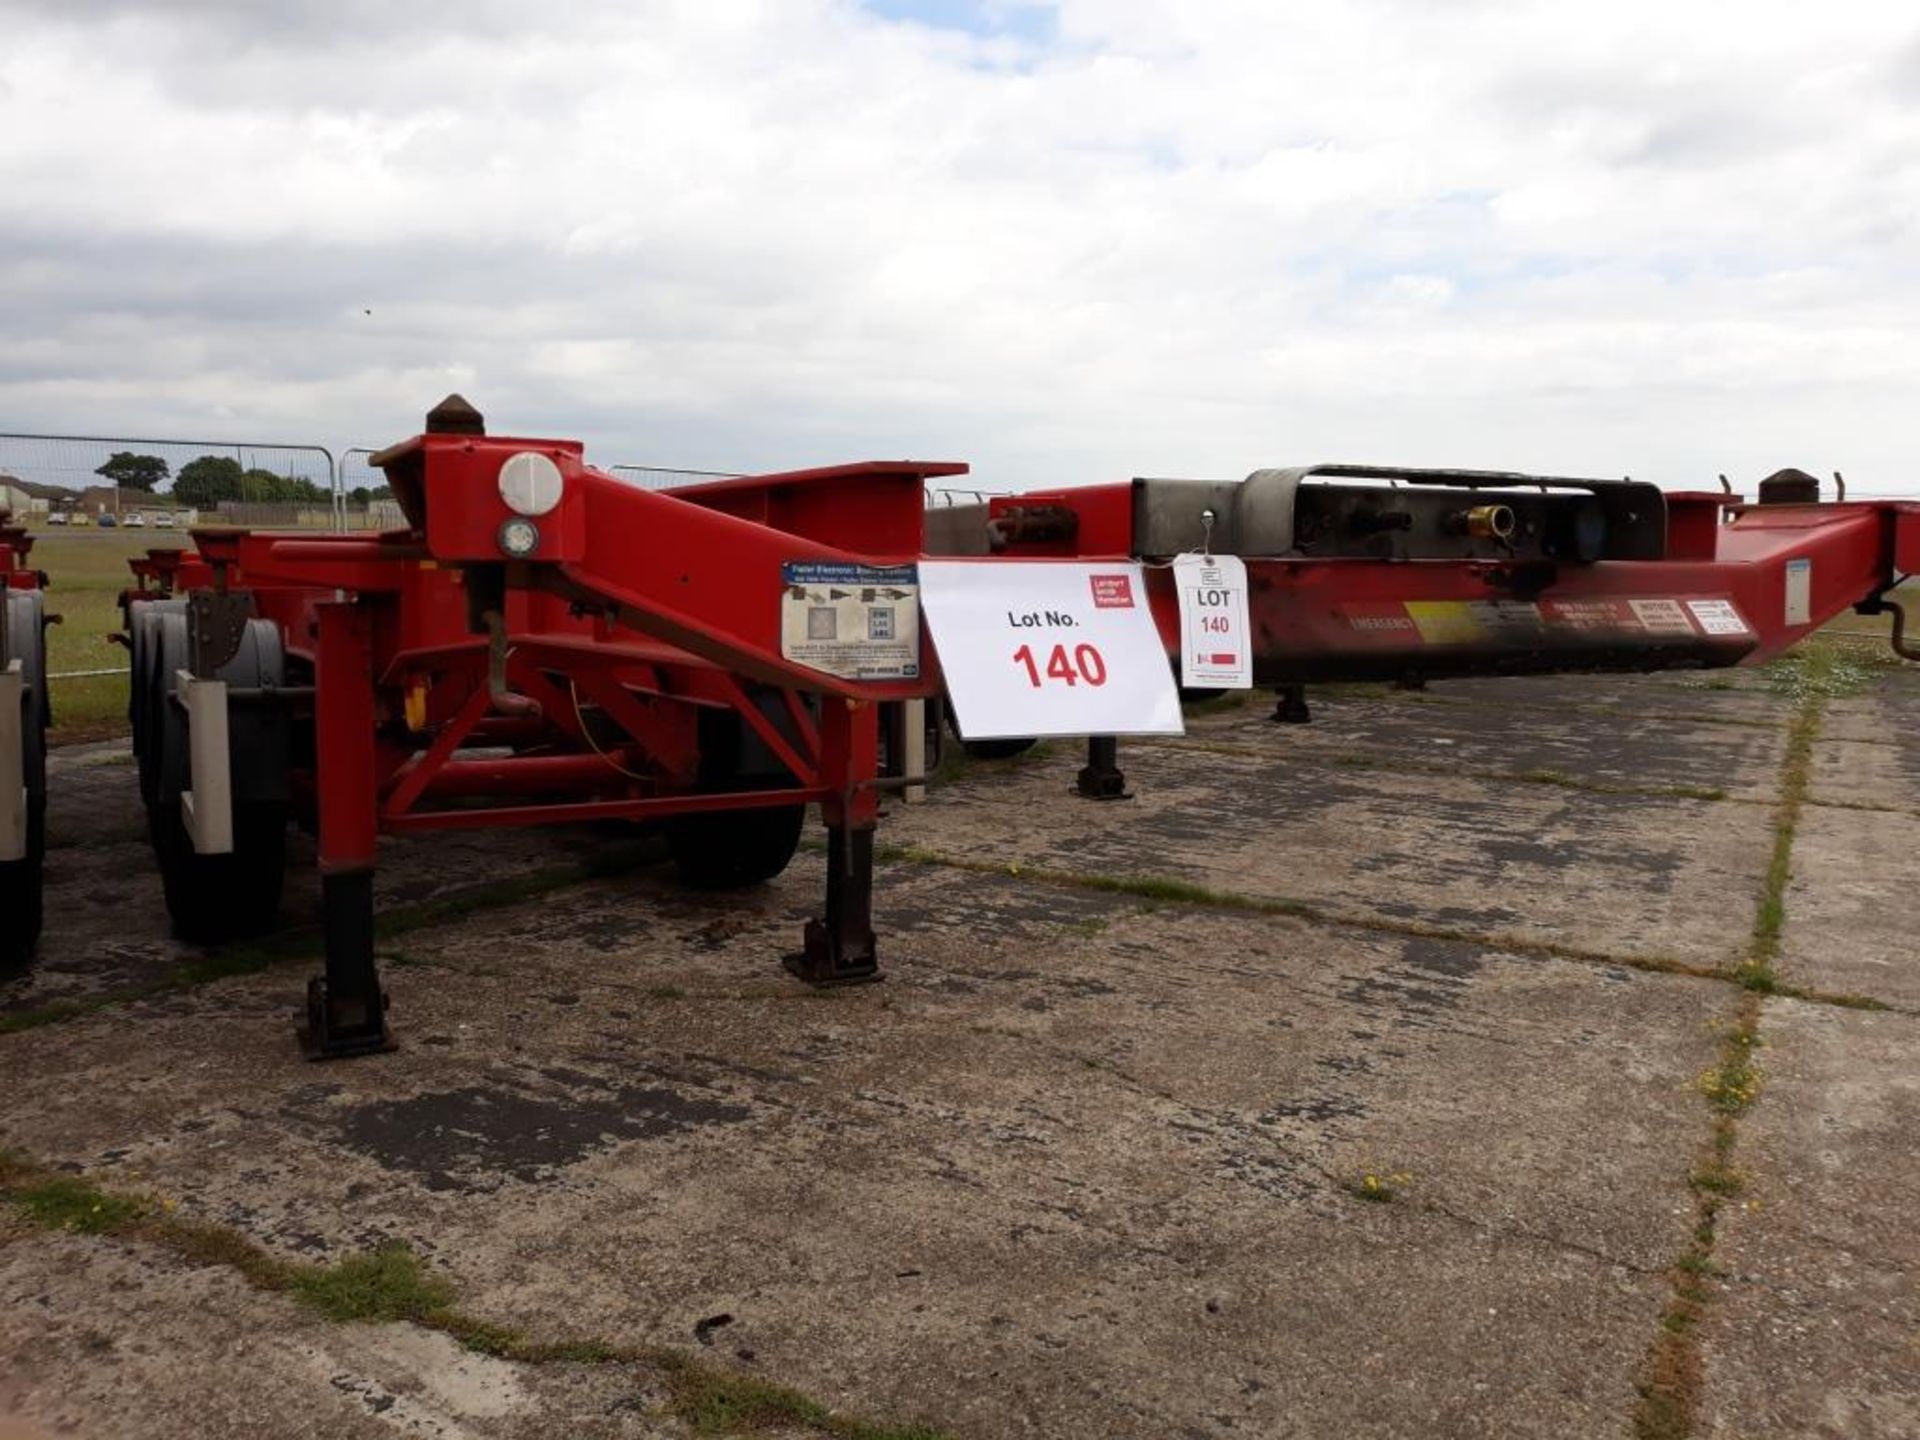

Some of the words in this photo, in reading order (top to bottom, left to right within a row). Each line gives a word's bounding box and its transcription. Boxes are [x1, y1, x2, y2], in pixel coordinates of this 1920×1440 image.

[1197, 590, 1231, 607] LOT
[1008, 611, 1043, 629] Lot
[1047, 609, 1080, 627] No.
[1201, 616, 1230, 634] 140
[1013, 643, 1108, 688] 140
